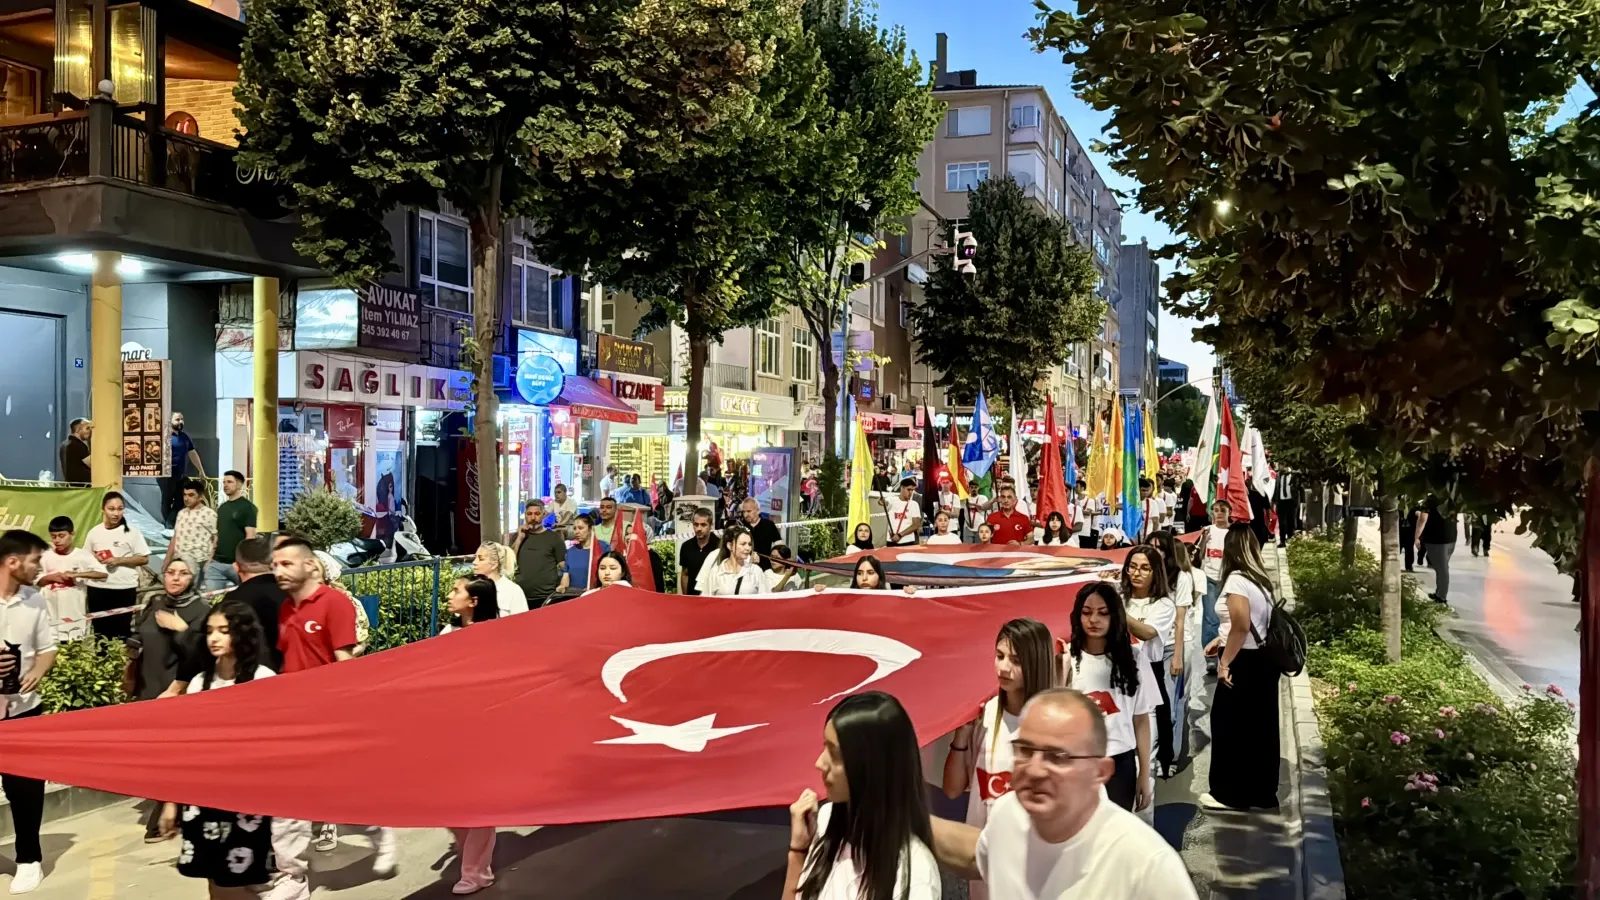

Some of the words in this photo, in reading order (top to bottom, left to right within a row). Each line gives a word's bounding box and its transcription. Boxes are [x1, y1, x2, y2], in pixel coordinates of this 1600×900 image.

[367, 285, 417, 312] AVUKAT
[384, 310, 419, 328] YILMAZ
[305, 362, 447, 401] SAĞLIK
[616, 380, 656, 402] ECZANE
